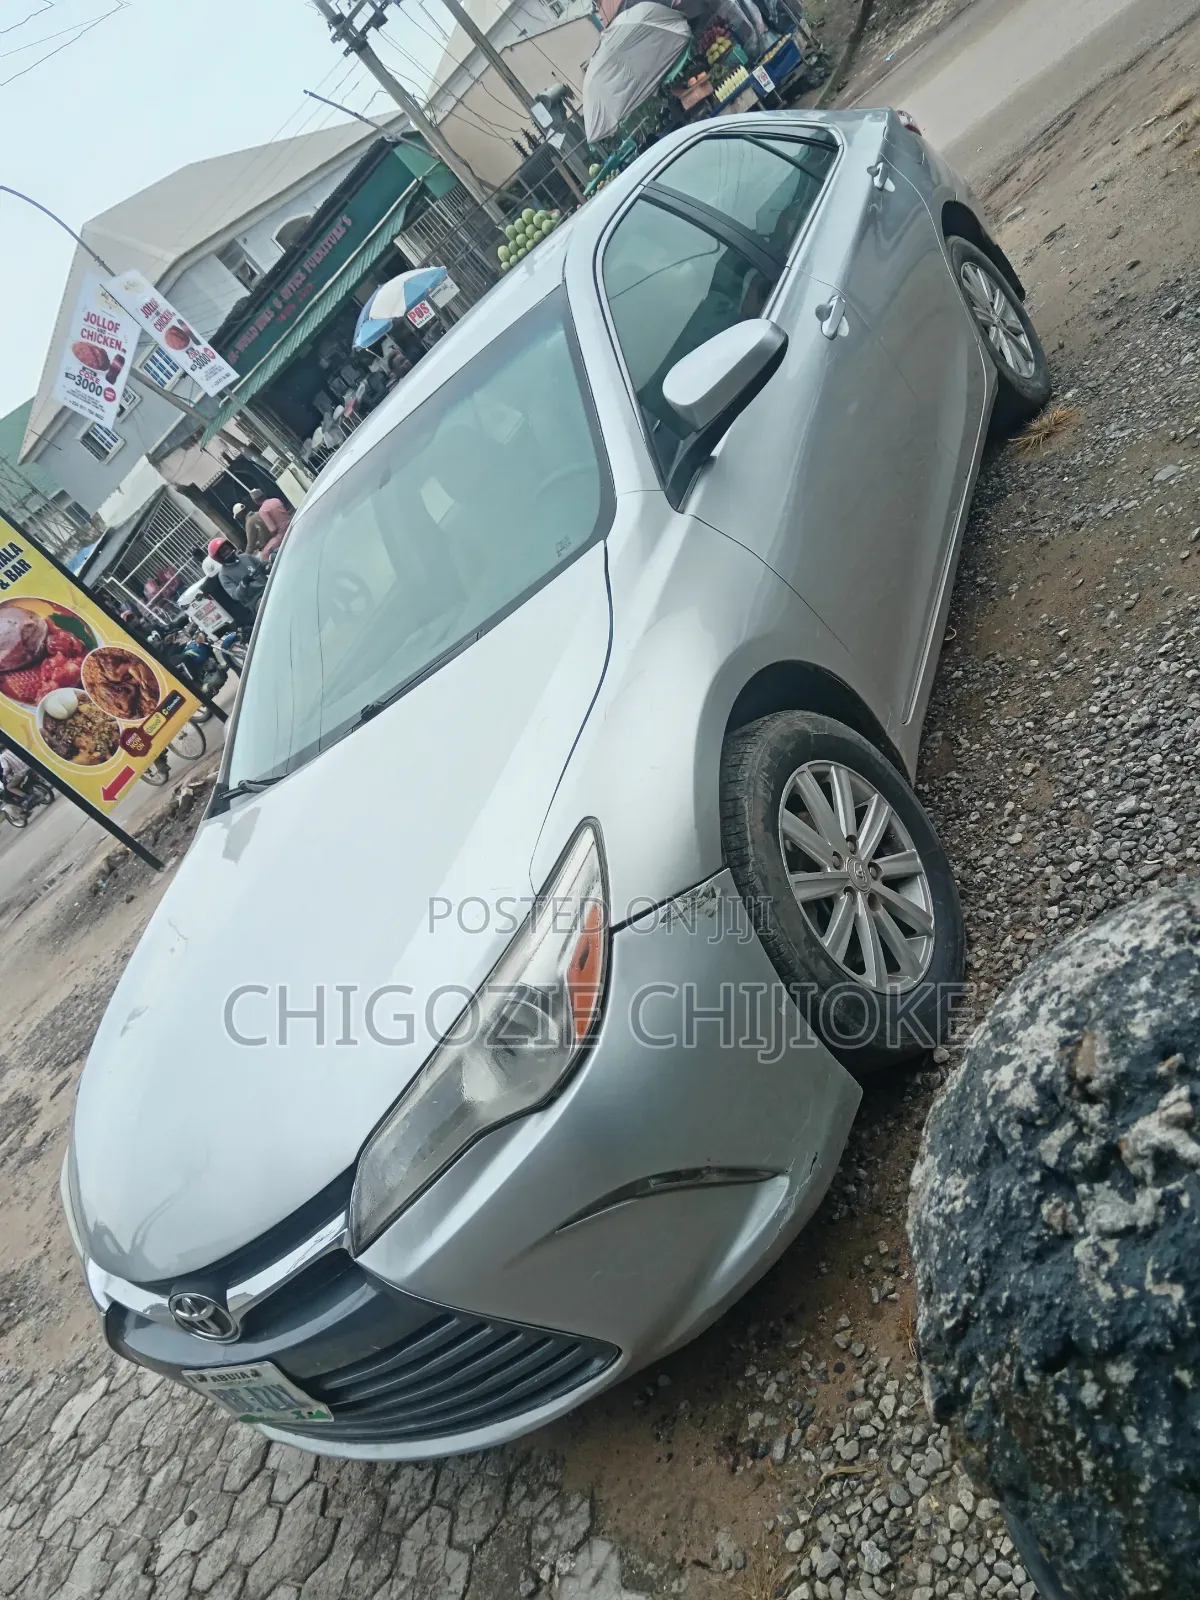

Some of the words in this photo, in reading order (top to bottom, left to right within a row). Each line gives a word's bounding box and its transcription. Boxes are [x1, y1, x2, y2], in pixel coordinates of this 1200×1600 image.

[141, 298, 160, 318] JOLLOF
[408, 302, 430, 324] POS
[83, 311, 120, 334] JOLLOF
[81, 328, 123, 351] CHICKEN
[194, 353, 211, 369] 3000
[75, 375, 103, 397] 3000
[79, 370, 101, 385] COKE
[3, 558, 32, 583] BAR
[130, 735, 142, 749] NOW
[136, 743, 145, 751] ON
